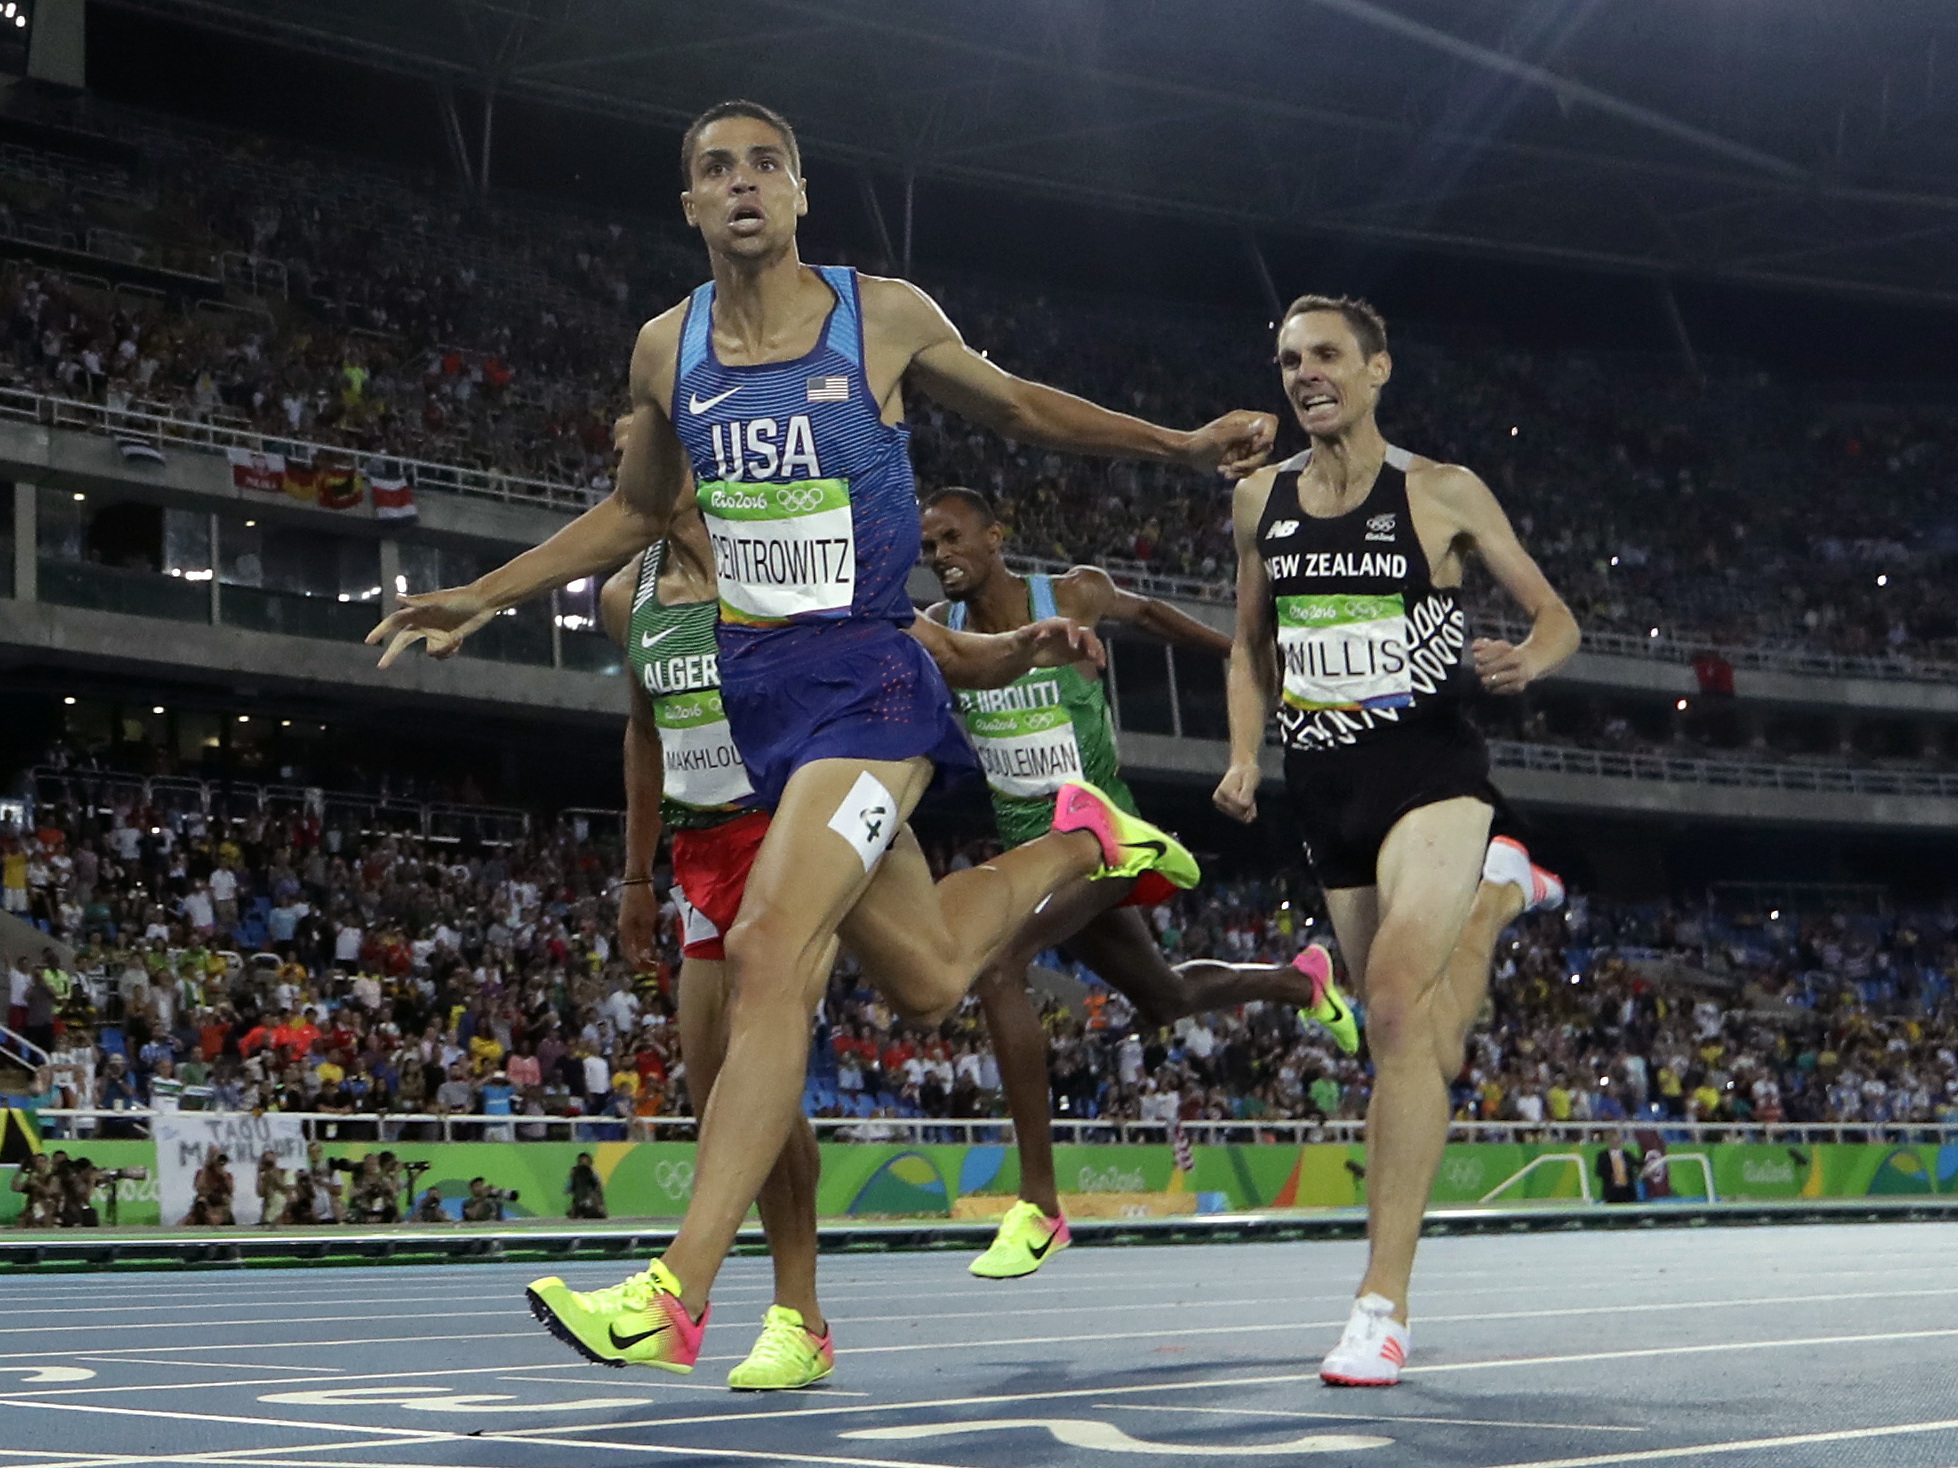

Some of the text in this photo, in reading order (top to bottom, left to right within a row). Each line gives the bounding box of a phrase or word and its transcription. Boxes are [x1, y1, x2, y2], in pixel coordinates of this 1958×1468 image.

[712, 415, 821, 481] USA
[711, 490, 768, 509] Rio2016
[1264, 552, 1407, 581] NEW ZEALAND
[644, 653, 721, 694] ALGER
[1283, 640, 1405, 677] WILLIS
